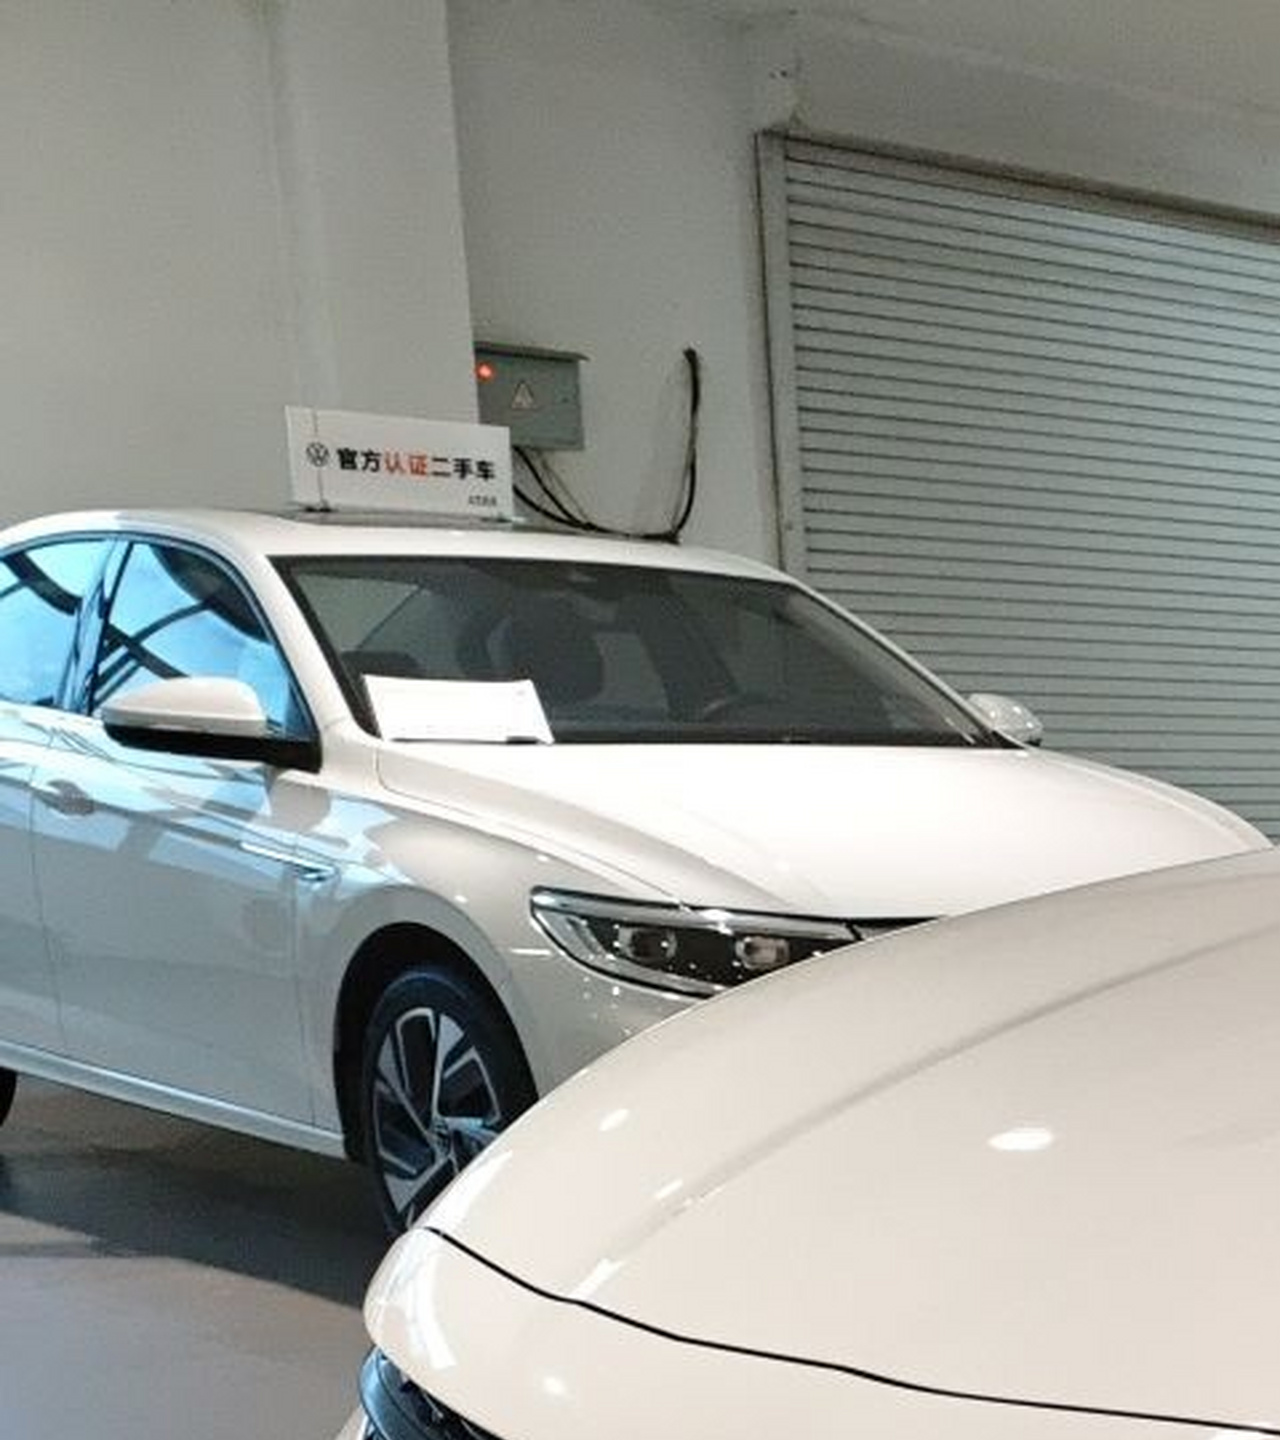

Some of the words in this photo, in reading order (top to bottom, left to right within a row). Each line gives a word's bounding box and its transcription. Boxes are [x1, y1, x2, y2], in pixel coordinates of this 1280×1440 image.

[337, 447, 496, 482] 官方认证二手车
